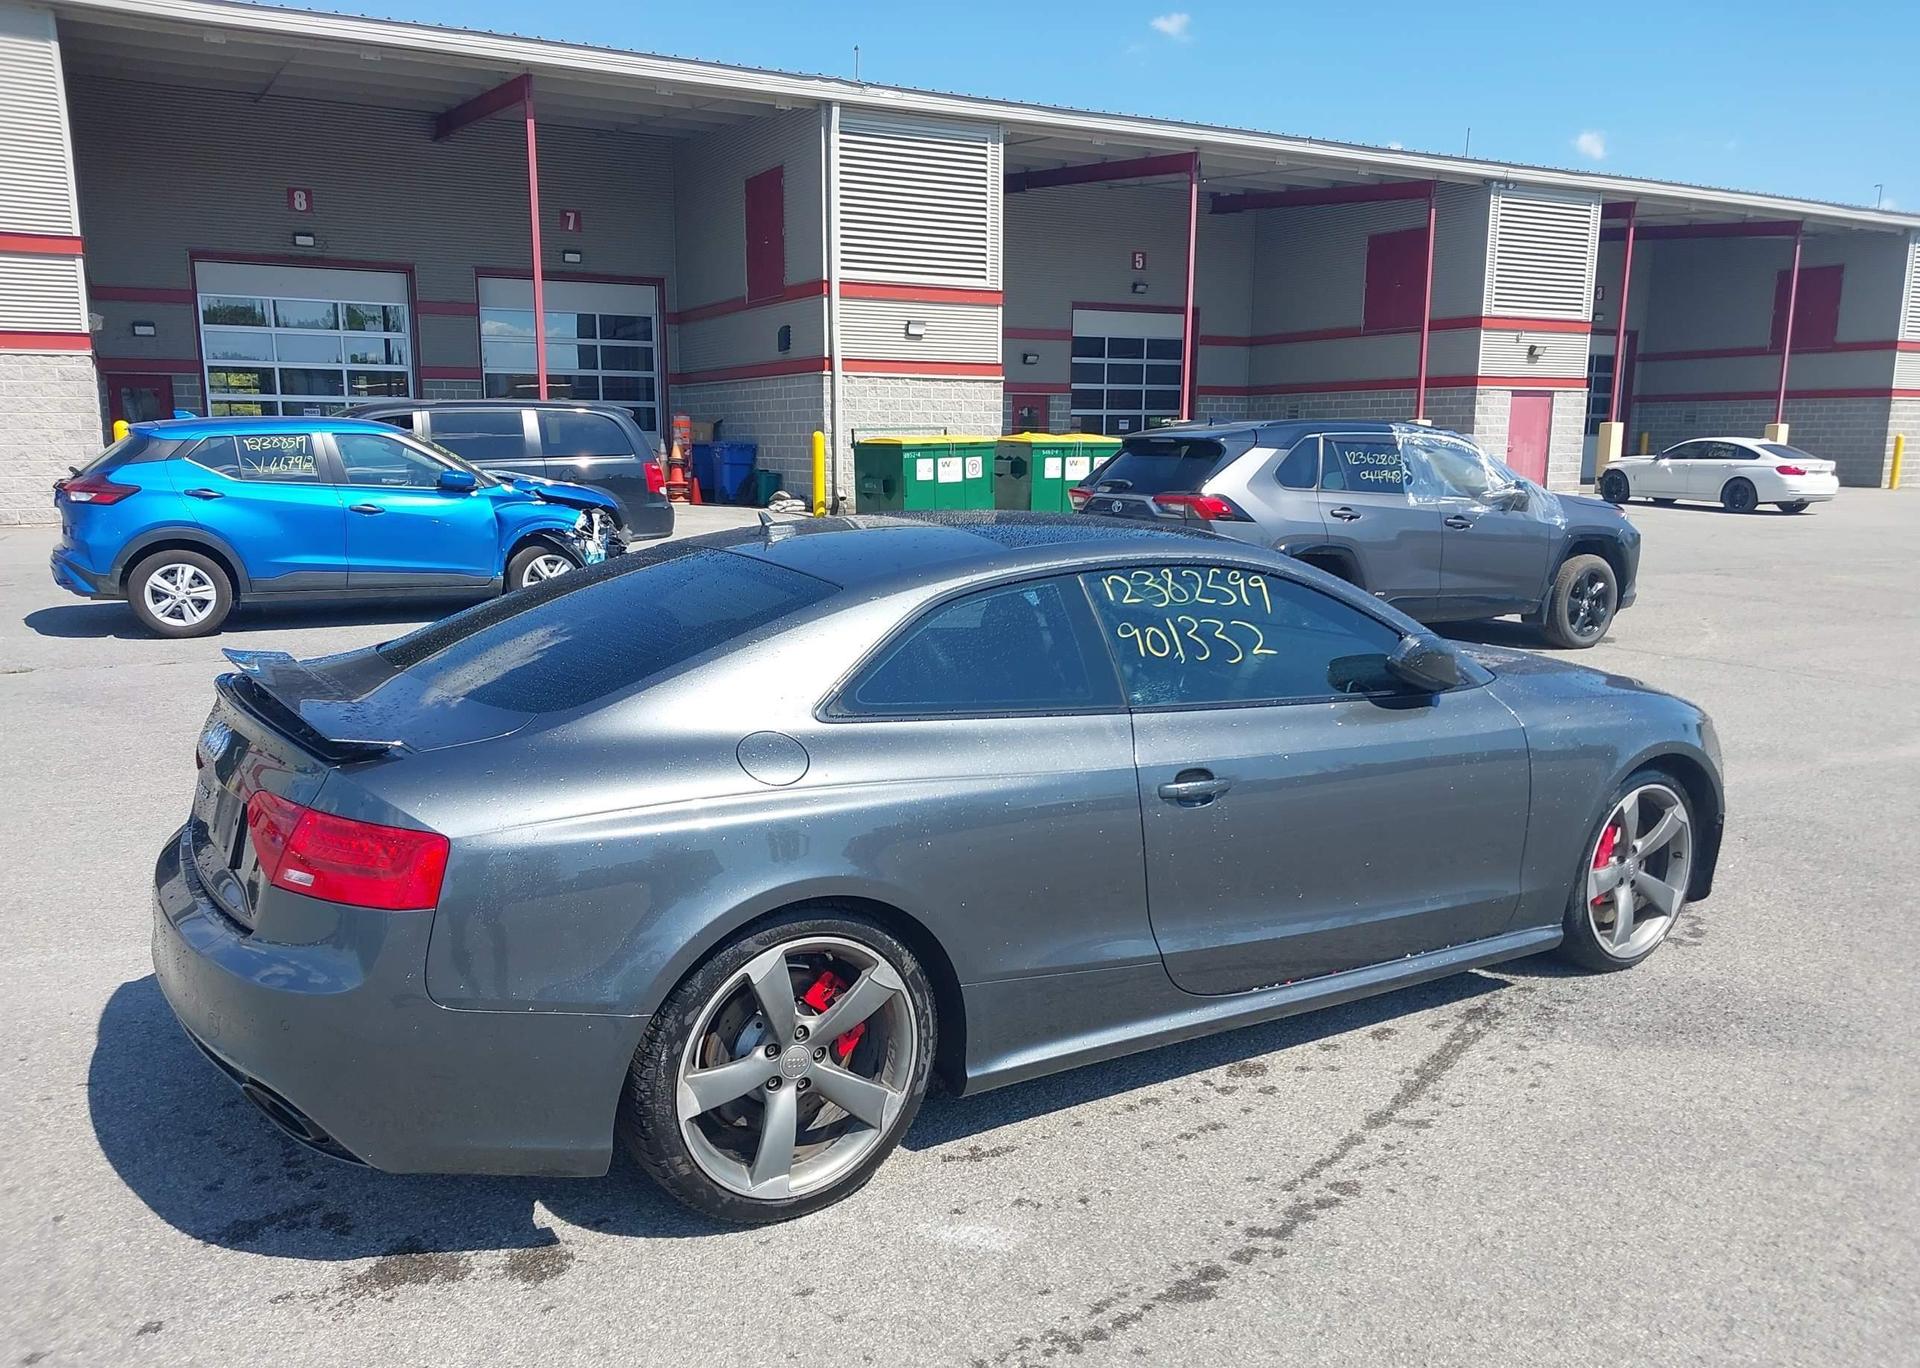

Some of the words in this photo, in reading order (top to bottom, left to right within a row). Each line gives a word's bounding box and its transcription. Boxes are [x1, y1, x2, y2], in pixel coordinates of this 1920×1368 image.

[293, 190, 307, 211] 8
[565, 211, 576, 231] 7
[1135, 253, 1144, 269] 5
[1596, 286, 1603, 300] 3
[1101, 567, 1272, 615] 12382599
[1117, 615, 1279, 664] 901332
